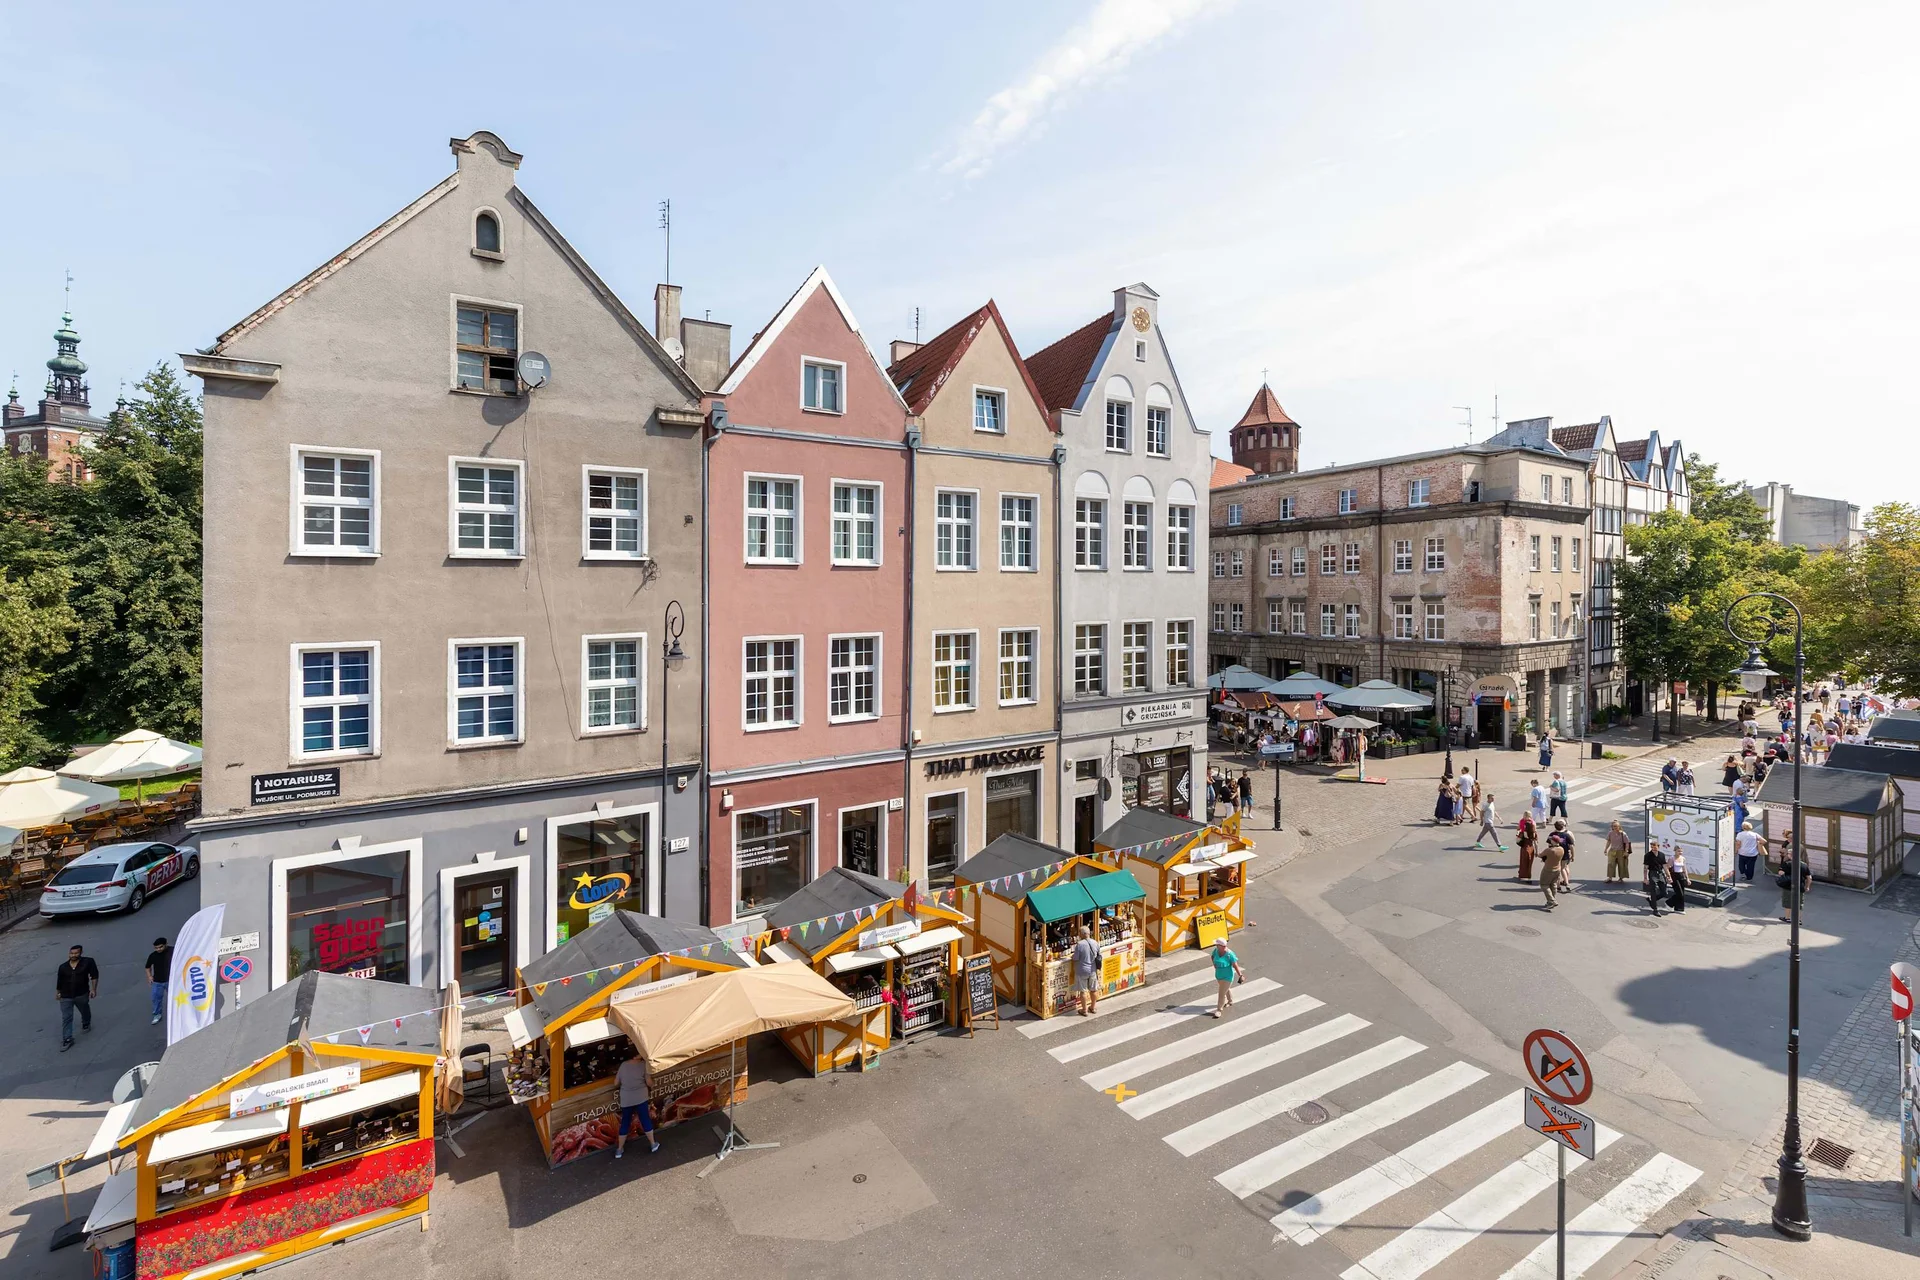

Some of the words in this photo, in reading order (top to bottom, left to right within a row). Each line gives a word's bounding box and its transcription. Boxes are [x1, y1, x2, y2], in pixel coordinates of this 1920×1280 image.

[1141, 703, 1177, 713] PIEKARNIA
[1141, 711, 1176, 720] GRUZIŃSKA
[926, 757, 966, 776] THAI
[973, 745, 1045, 769] MASSAGE
[264, 773, 333, 788] NOTARIUSZ
[255, 794, 284, 803] WEJŚCIE
[296, 790, 332, 799] PODMURZE
[673, 839, 687, 848] 127
[150, 854, 181, 889] PERŁA
[581, 878, 620, 903] LOTTO
[313, 916, 385, 942] Salon
[320, 932, 383, 965] gier
[189, 966, 207, 1001] LOTTO
[265, 1084, 305, 1098] GÓRALSKIE
[306, 1077, 329, 1088] SMAKI
[650, 1078, 693, 1100] ITEWSKIE
[694, 1068, 732, 1085] WYROBY
[653, 1065, 698, 1087] ITEWSKIE
